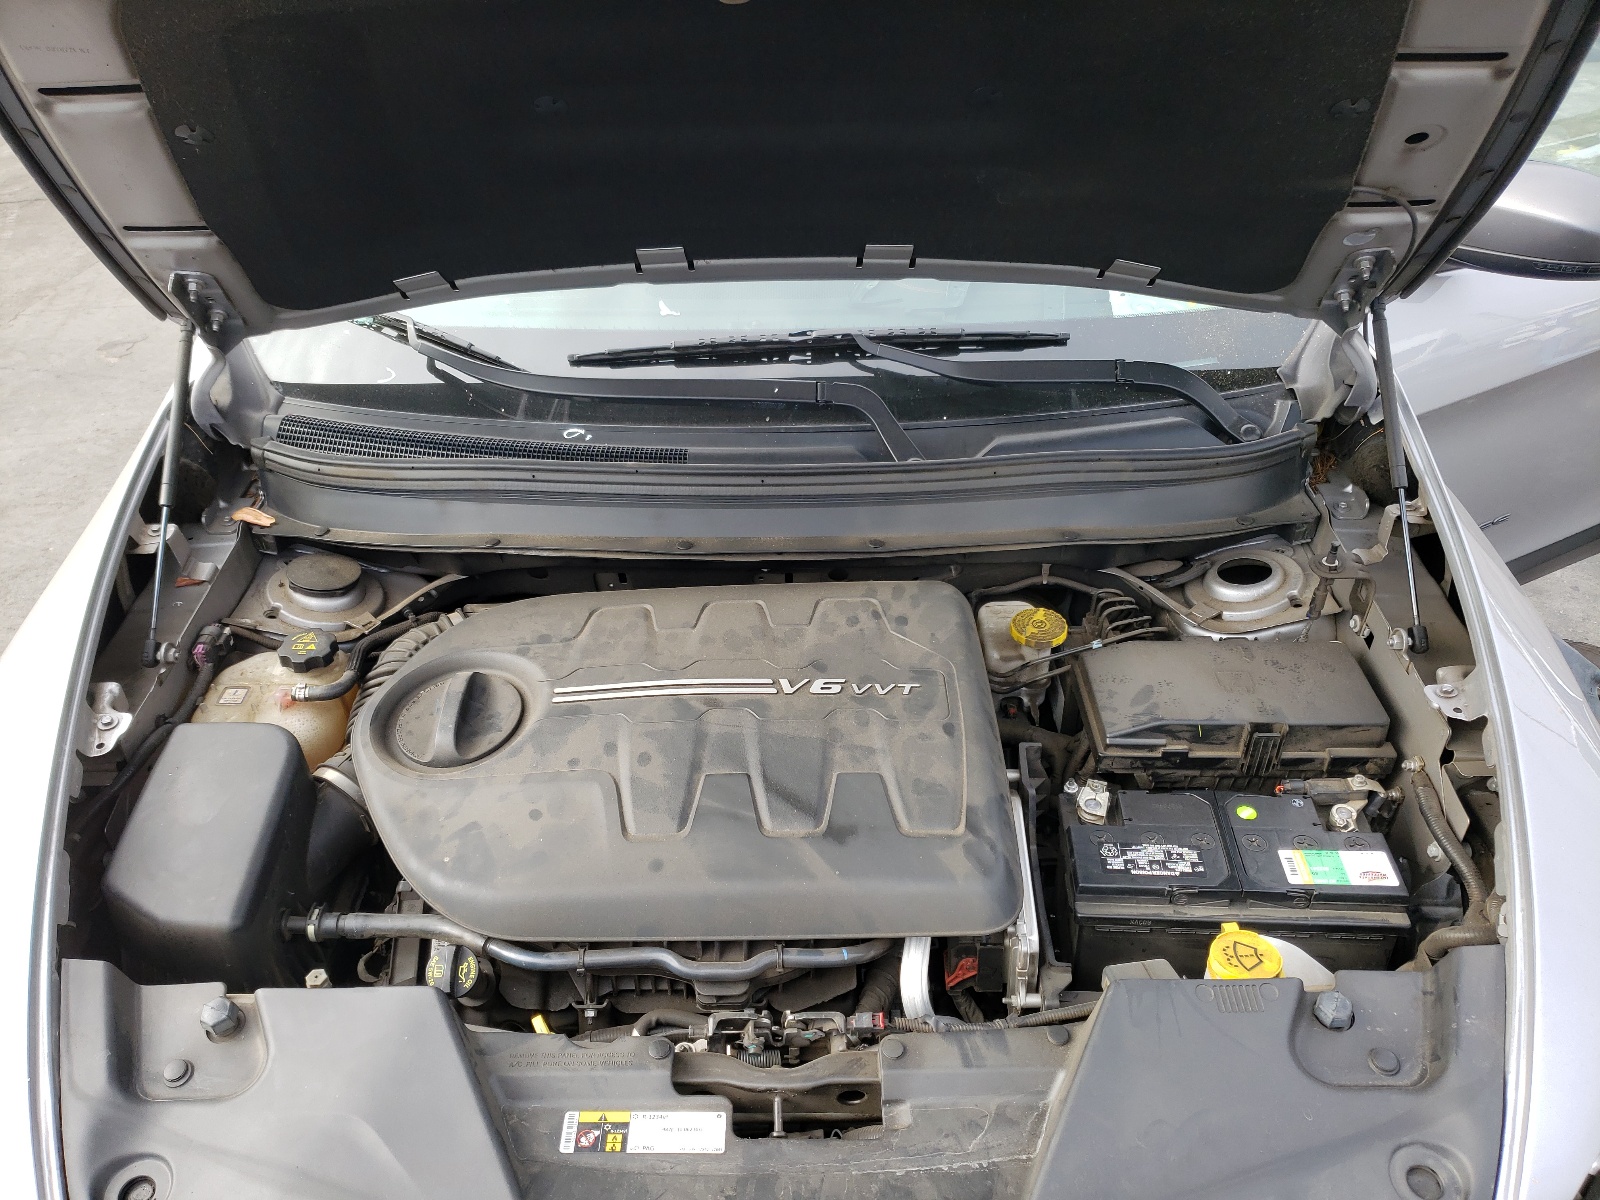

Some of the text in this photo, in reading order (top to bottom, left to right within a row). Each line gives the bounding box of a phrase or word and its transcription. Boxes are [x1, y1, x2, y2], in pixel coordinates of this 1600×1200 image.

[778, 678, 921, 695] V6 VVT
[463, 956, 476, 988] ENGINE OIL
